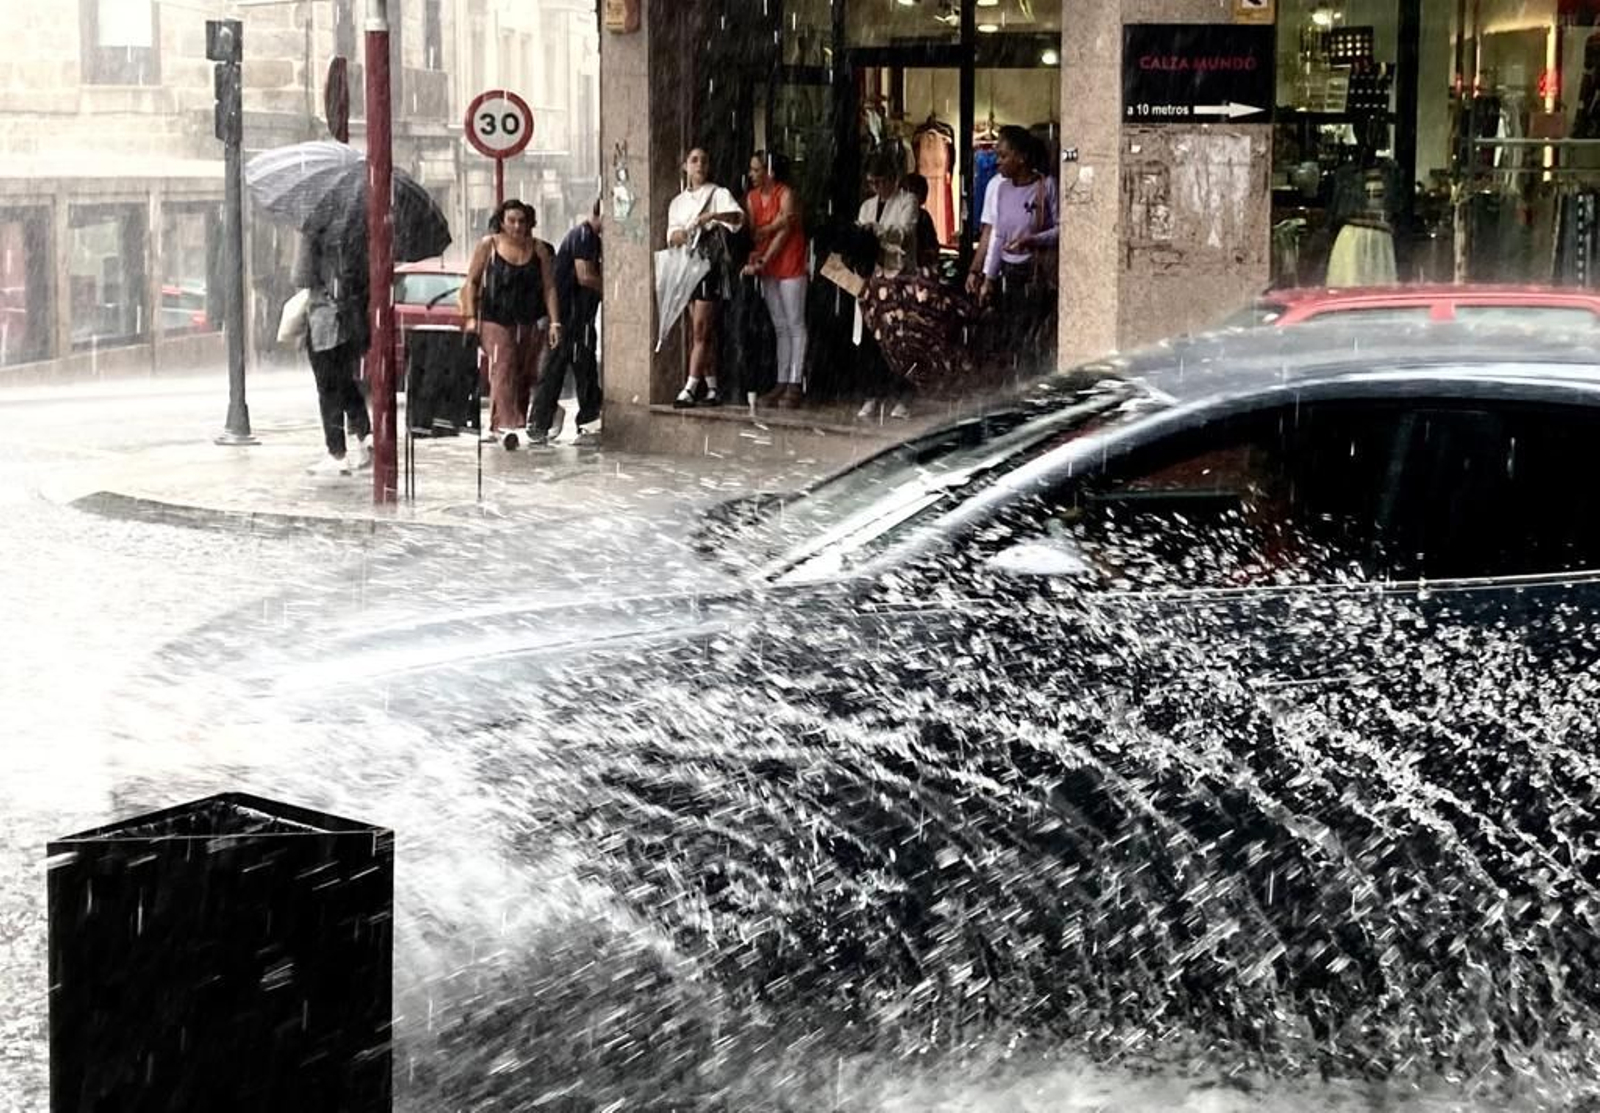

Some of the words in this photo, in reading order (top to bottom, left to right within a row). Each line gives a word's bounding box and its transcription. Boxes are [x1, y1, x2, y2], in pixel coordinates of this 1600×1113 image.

[1139, 56, 1189, 70] CALZA
[1192, 56, 1257, 70] MUNDO
[1127, 105, 1134, 115] a
[1136, 103, 1149, 115] 10
[1151, 104, 1189, 115] metros
[480, 112, 520, 135] 30
